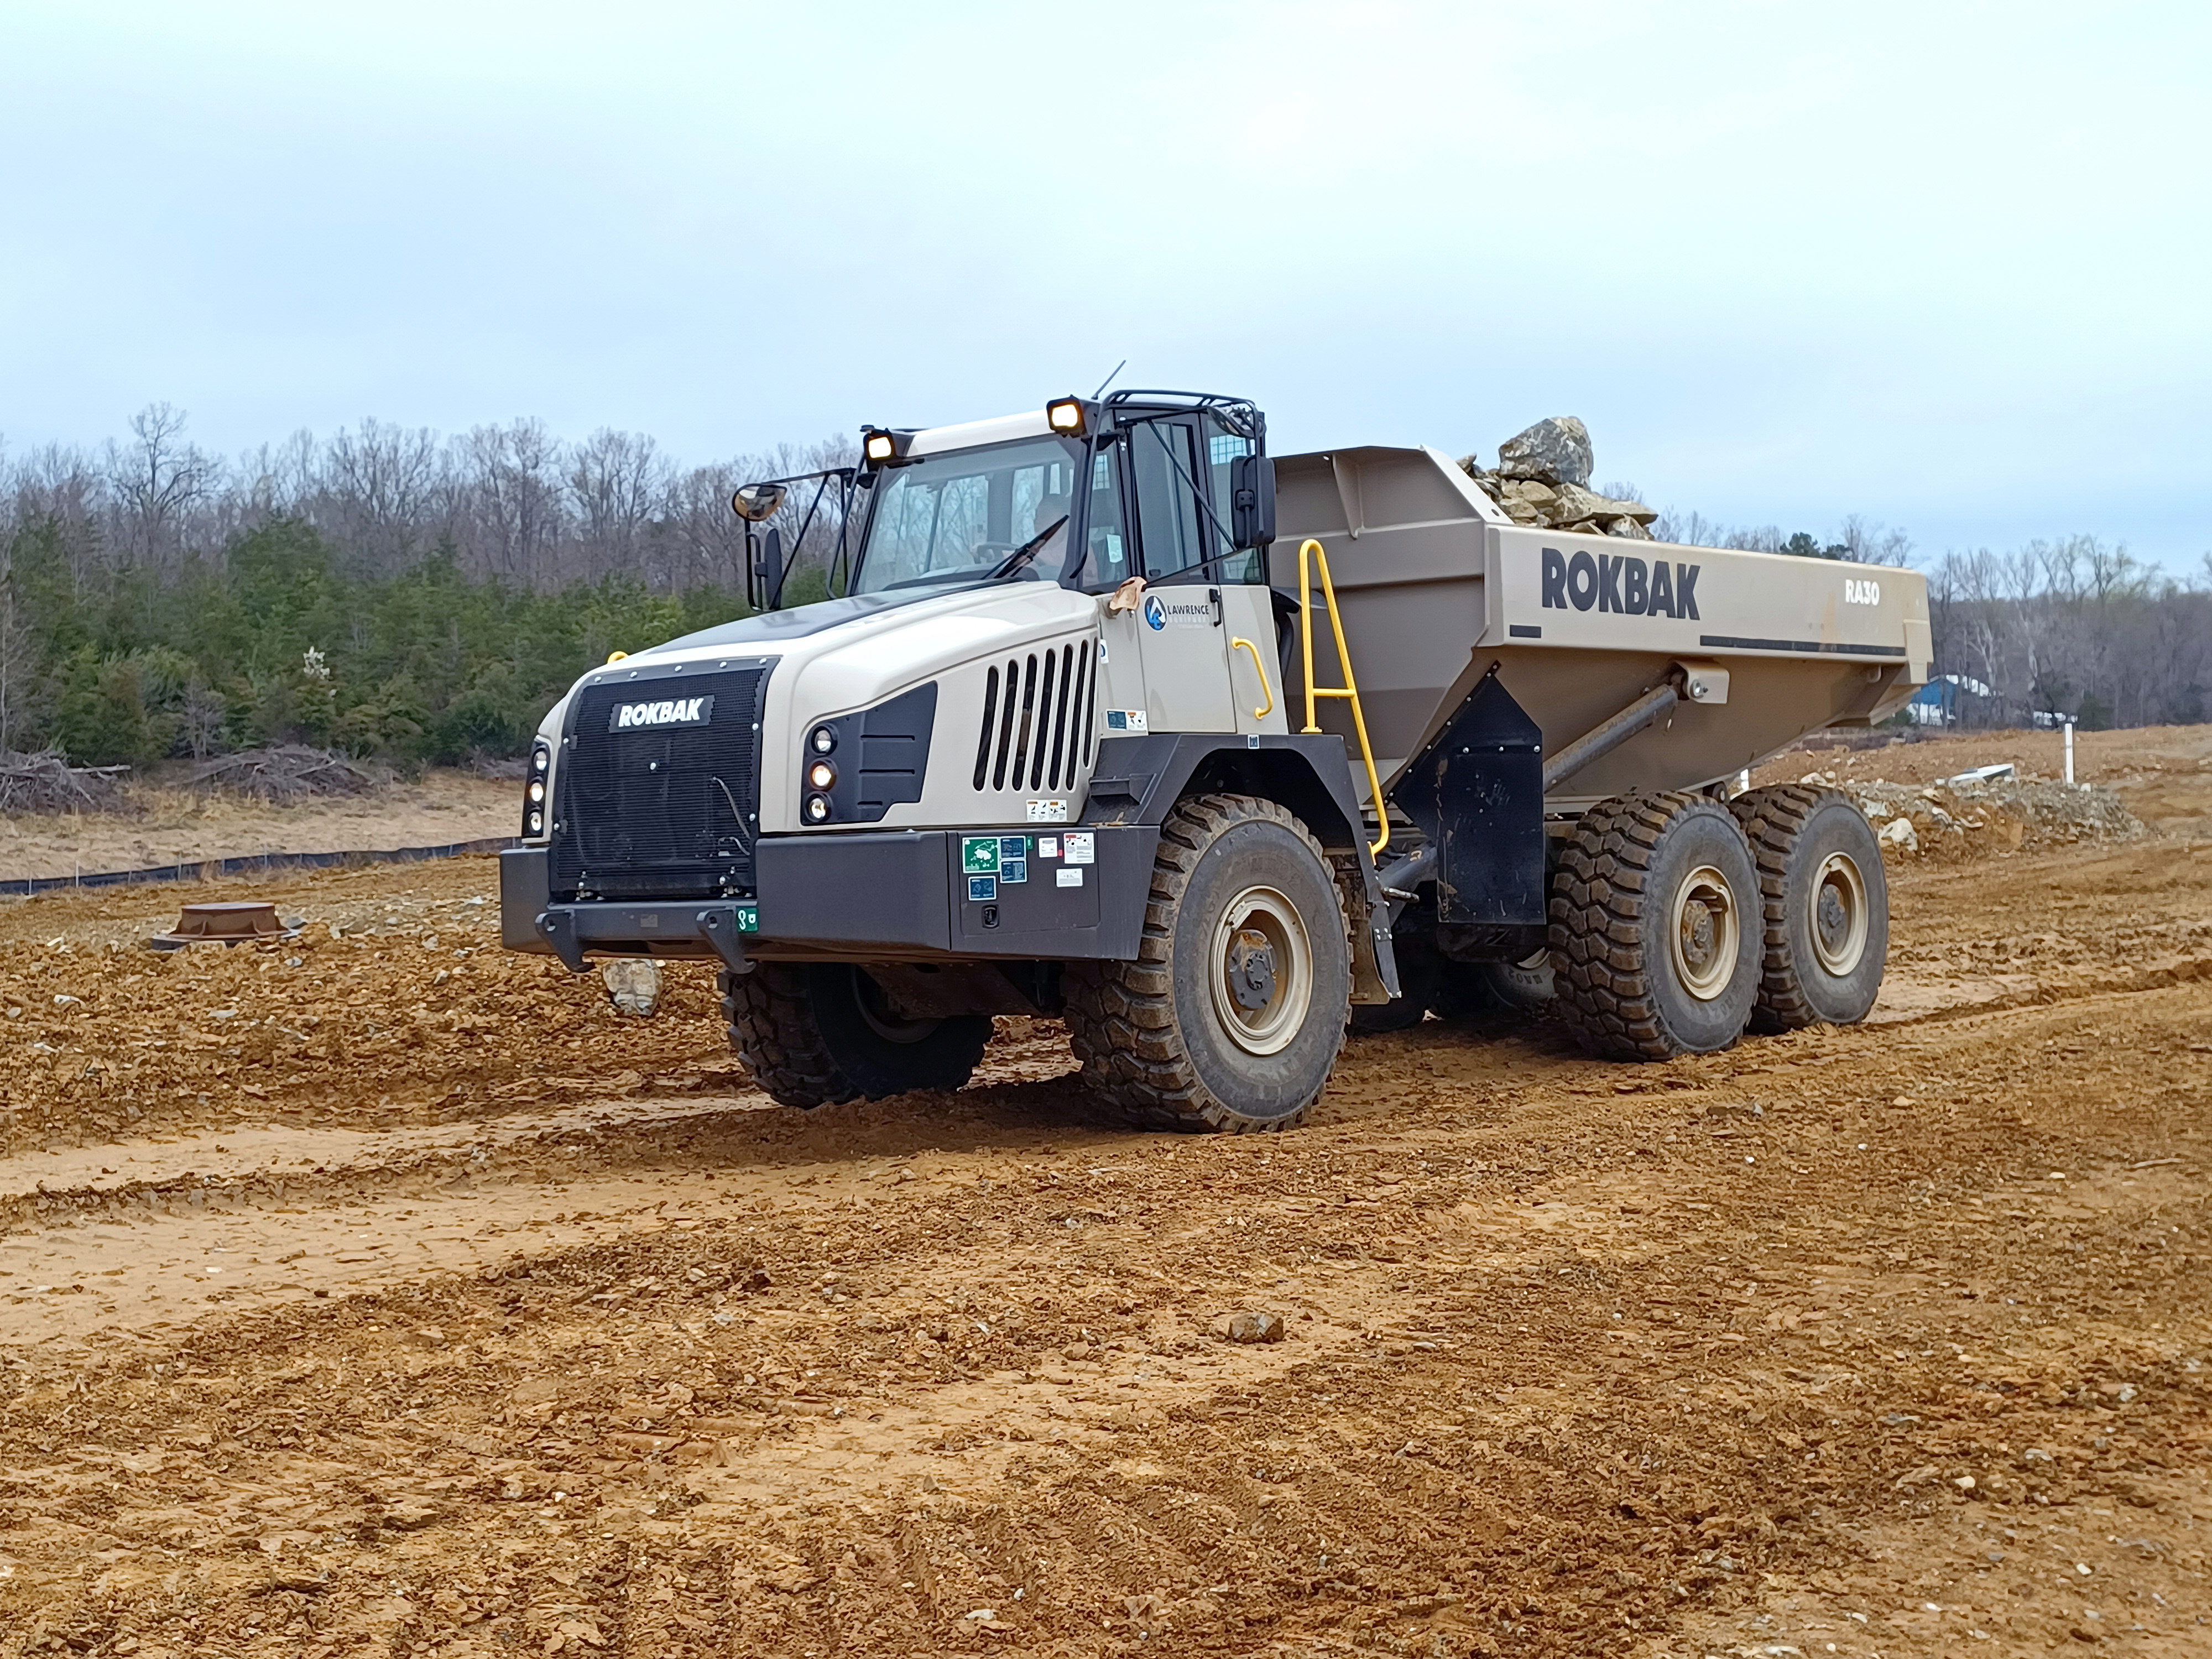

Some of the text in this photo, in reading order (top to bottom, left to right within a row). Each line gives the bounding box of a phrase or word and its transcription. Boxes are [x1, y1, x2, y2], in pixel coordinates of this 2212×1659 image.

[1542, 547, 1700, 620] ROKBAK
[1845, 579, 1880, 606] RA30
[1167, 604, 1209, 615] LAWRENCE
[618, 697, 704, 727] ROKBAK
